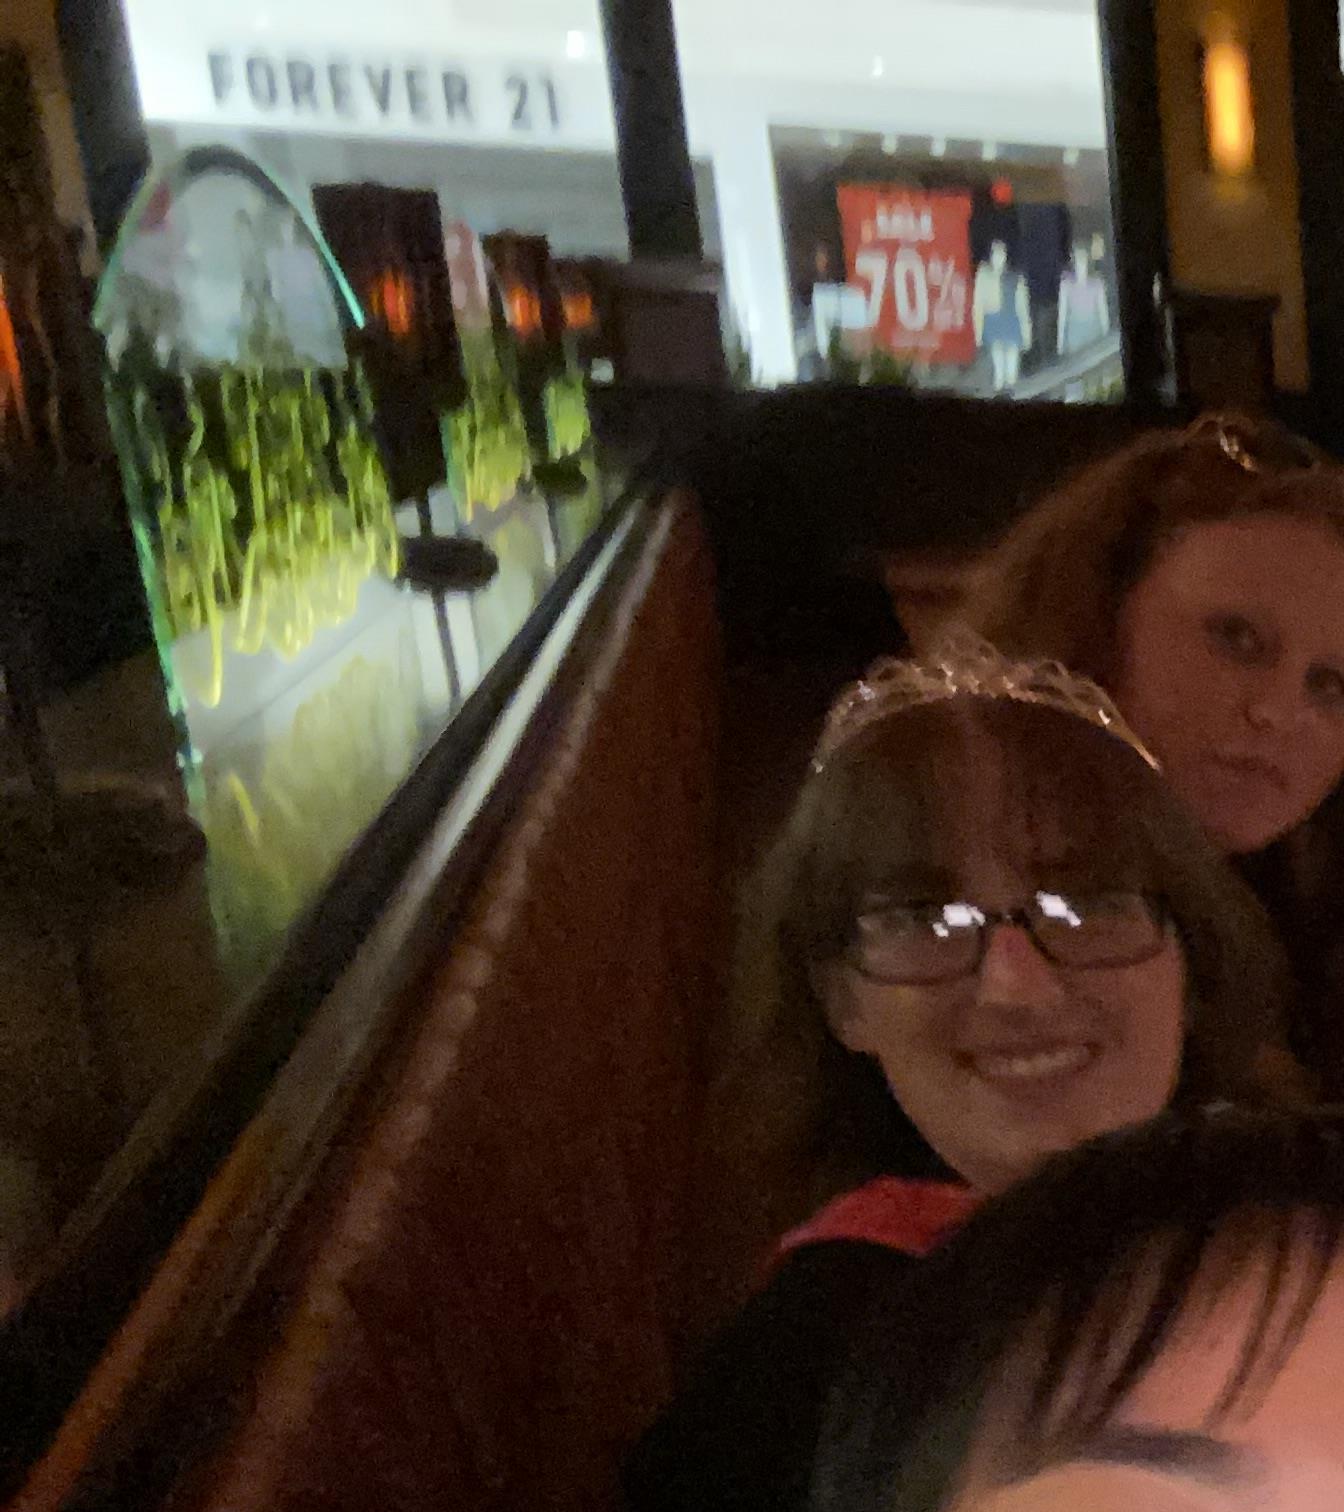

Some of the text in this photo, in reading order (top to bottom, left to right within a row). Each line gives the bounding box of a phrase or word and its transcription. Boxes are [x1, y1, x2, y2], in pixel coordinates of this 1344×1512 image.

[208, 51, 560, 130] FOREVER 21
[855, 247, 966, 332] 70%
